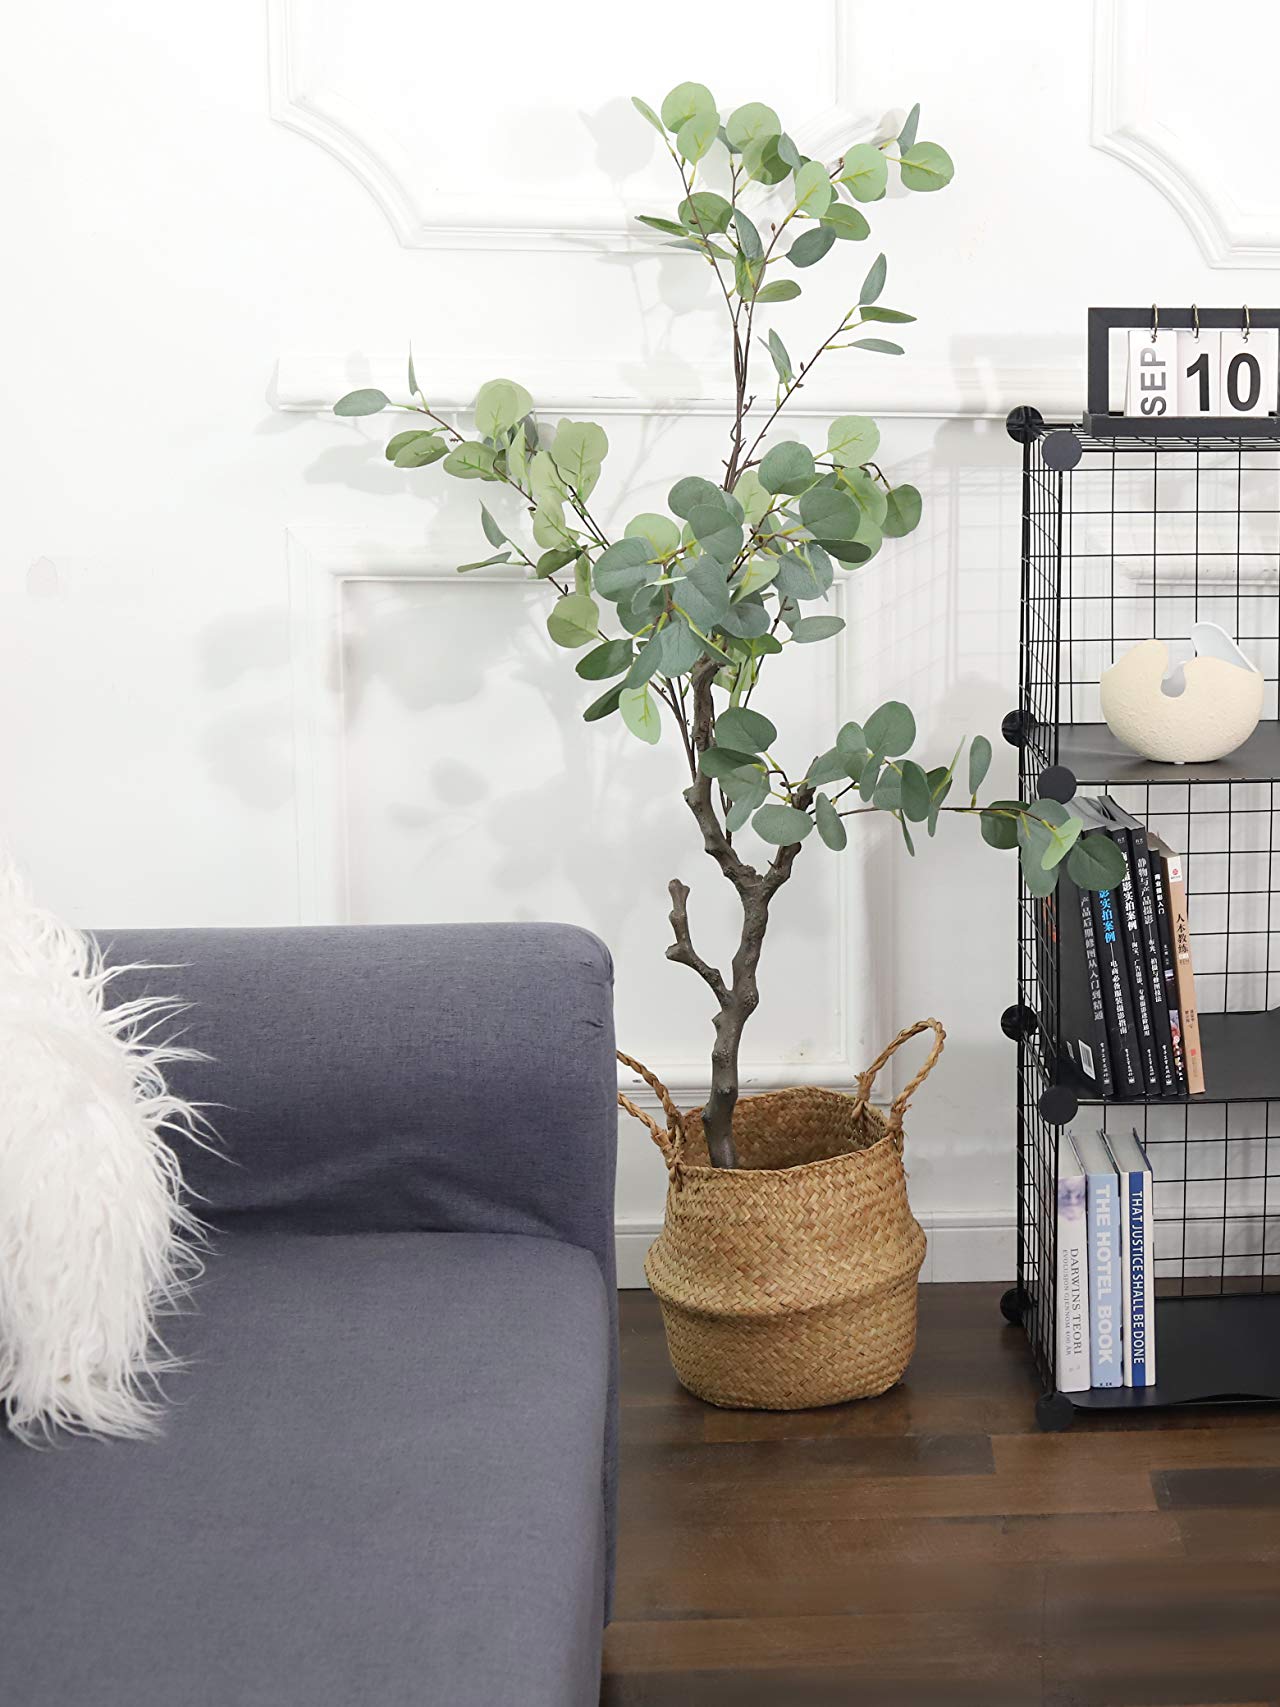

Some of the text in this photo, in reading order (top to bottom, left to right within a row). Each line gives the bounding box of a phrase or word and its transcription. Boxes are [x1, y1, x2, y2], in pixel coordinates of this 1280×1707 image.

[1140, 347, 1167, 416] SEP
[1186, 352, 1261, 412] 10
[1080, 896, 1104, 1021] 产品后期修图从入门到精通
[1096, 1183, 1111, 1226] THE
[1096, 1232, 1112, 1300] HOTEL
[1131, 1190, 1145, 1364] THAT JUSTICE SHALL BE DONE
[1070, 1247, 1082, 1355] DARWINS TEORI
[1097, 1304, 1113, 1365] BOOK
